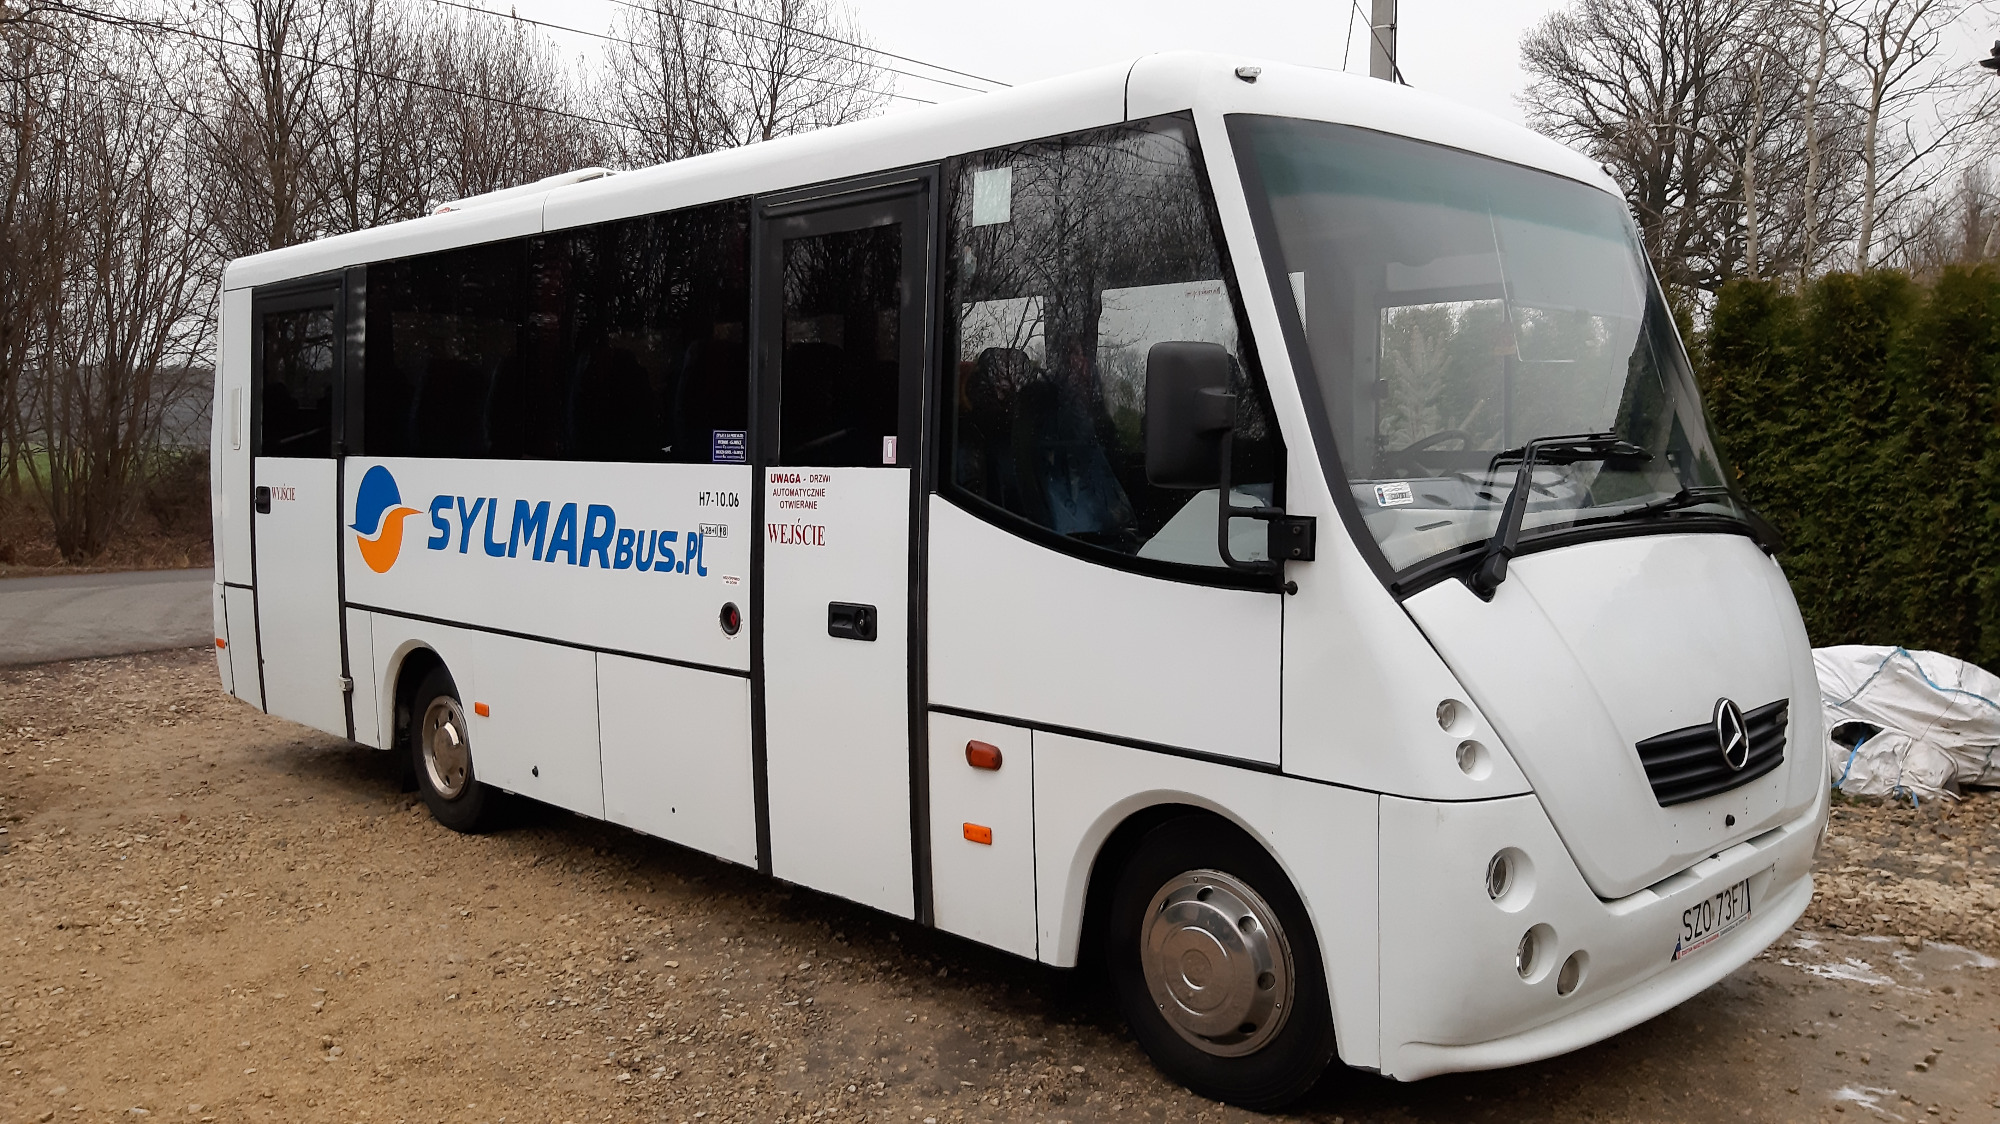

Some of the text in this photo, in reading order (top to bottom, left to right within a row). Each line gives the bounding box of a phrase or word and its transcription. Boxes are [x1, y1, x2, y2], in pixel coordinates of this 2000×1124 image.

[770, 473, 801, 484] UWAGA
[809, 474, 831, 483] DRZWI
[271, 483, 296, 501] WYJŚCIE
[699, 491, 740, 507] H7-10.06
[772, 488, 826, 497] AUTOMATYCZNIE
[779, 500, 818, 510] OTWIERANE
[767, 517, 826, 547] WEJŚCIE
[1682, 899, 1712, 942] SZO
